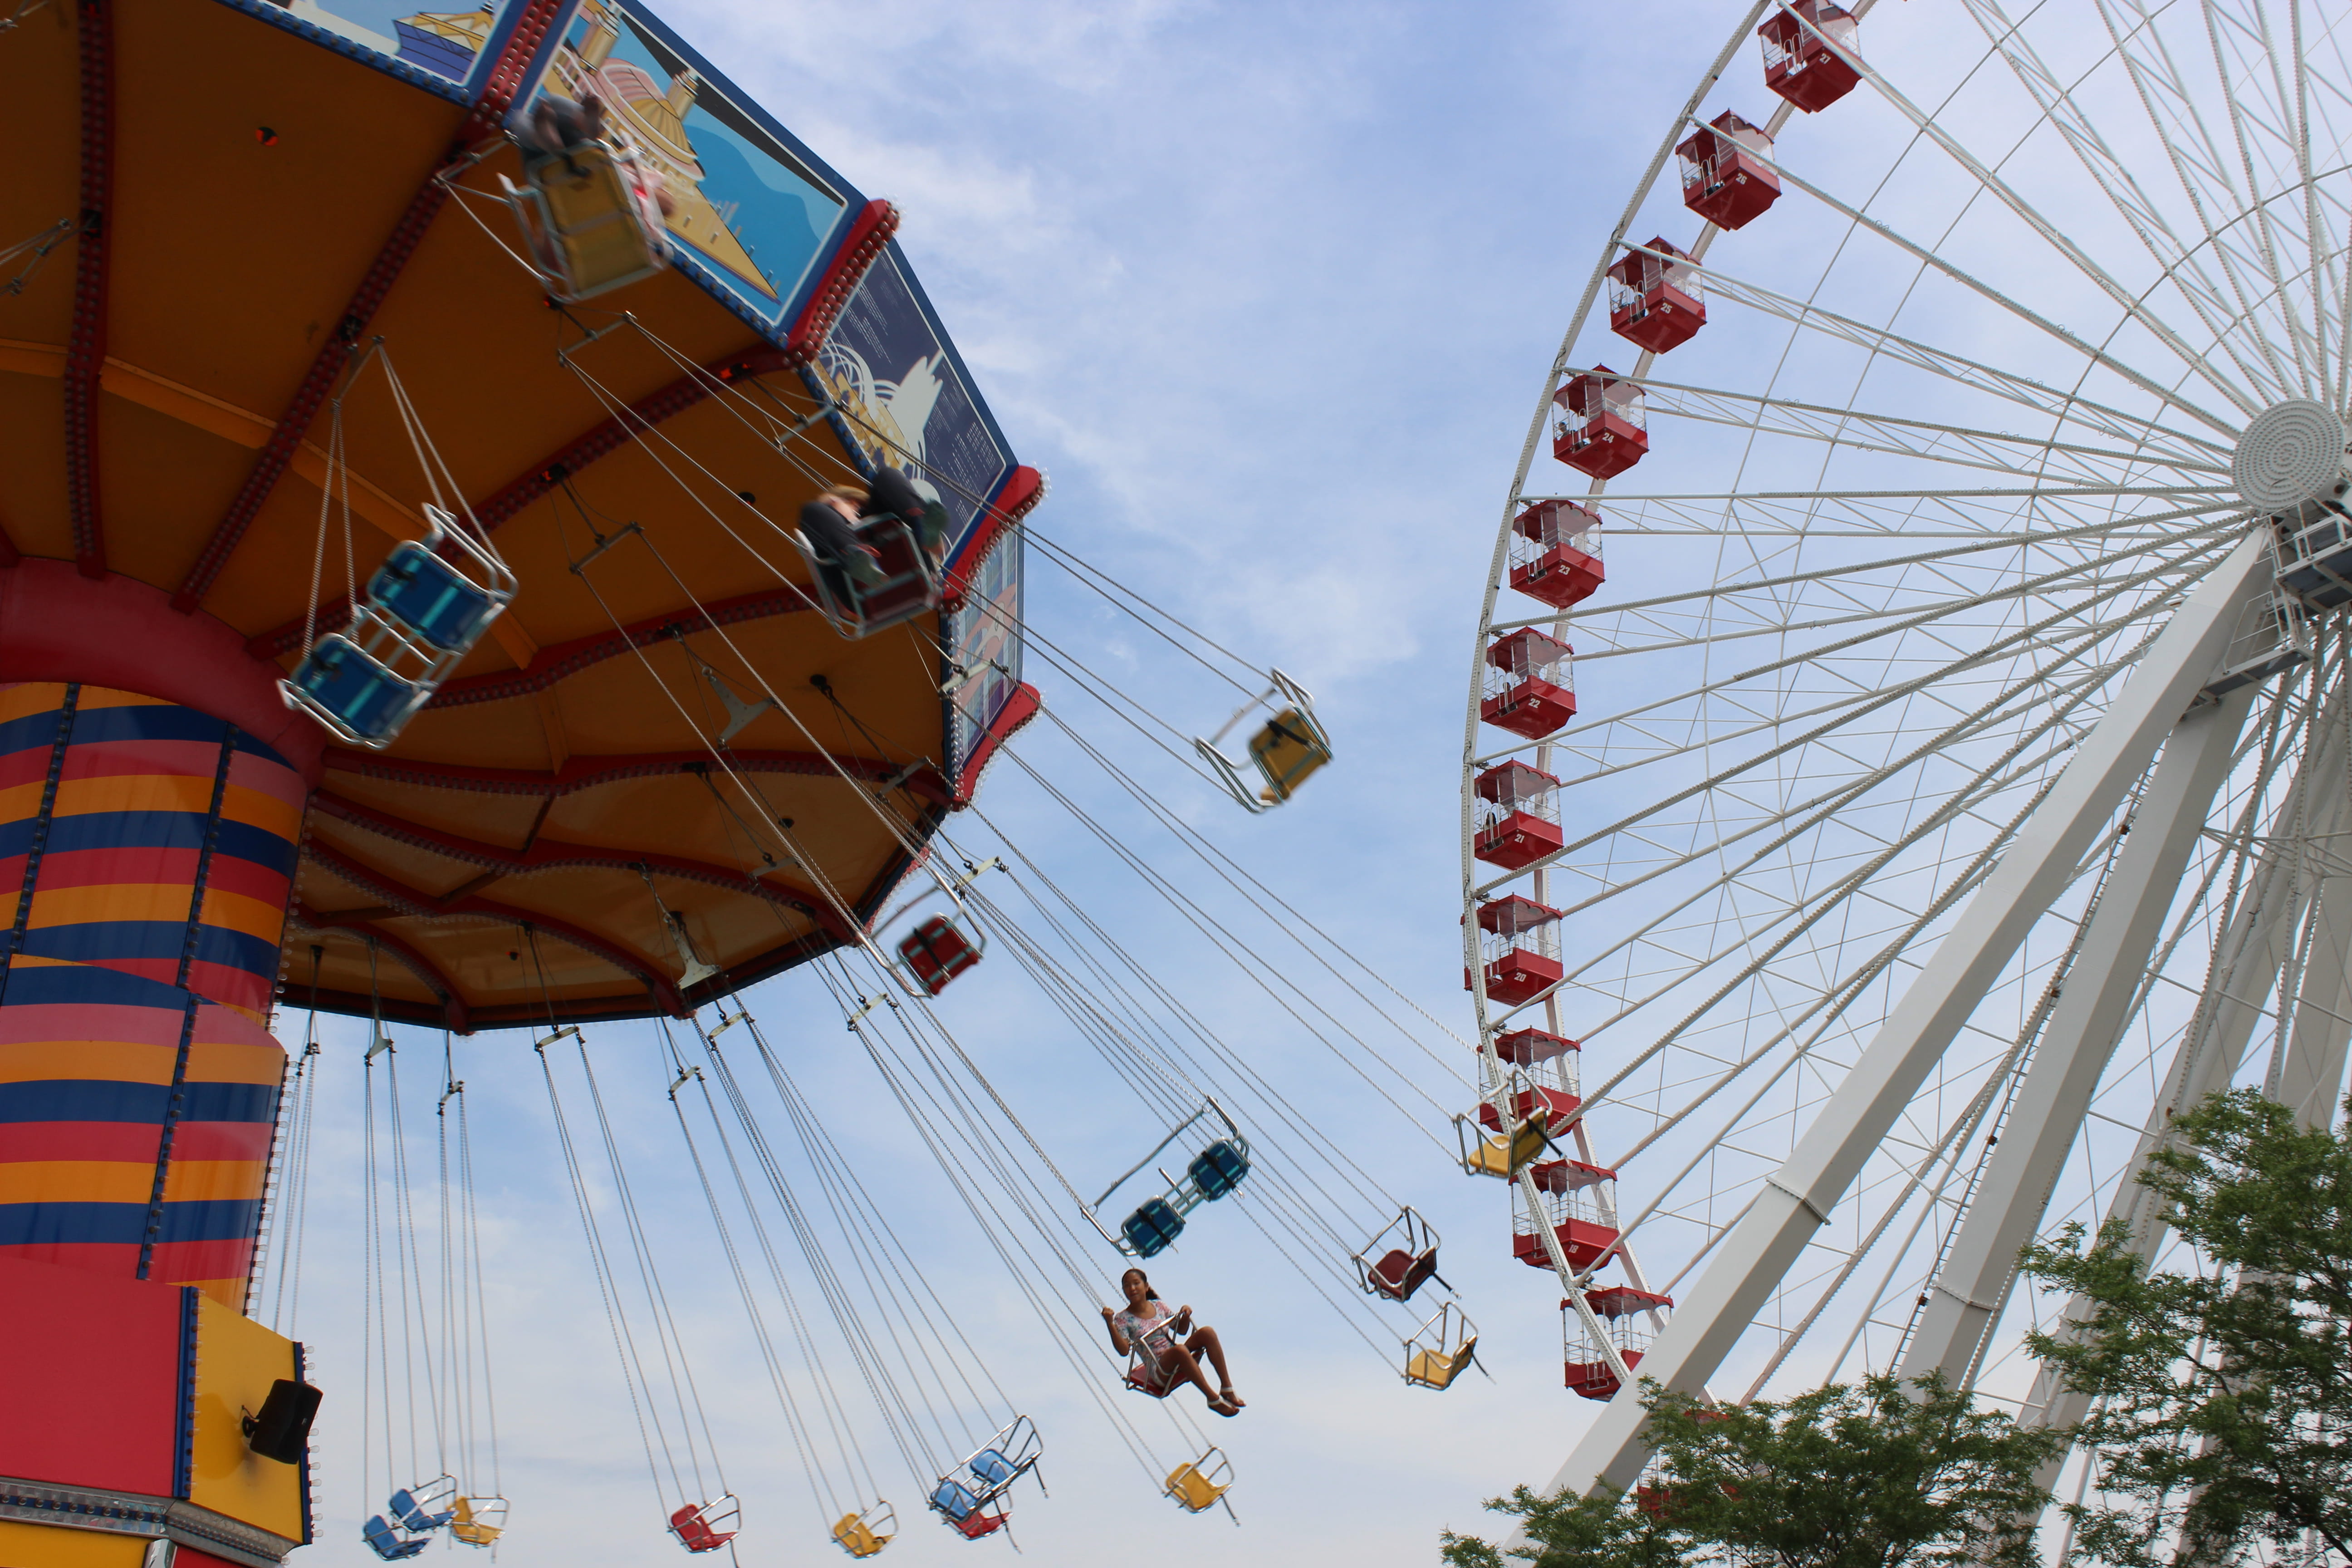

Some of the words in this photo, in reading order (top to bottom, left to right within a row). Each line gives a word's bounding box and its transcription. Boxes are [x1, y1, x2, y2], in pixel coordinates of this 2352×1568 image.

[1819, 53, 1831, 64] 27
[1735, 173, 1747, 185] 26
[1660, 302, 1672, 314] 25
[1602, 432, 1614, 443] 24
[1558, 564, 1570, 575] 23
[1528, 698, 1541, 708] 22
[1514, 833, 1525, 843] 21
[1514, 972, 1527, 982] 20
[1568, 1245, 1579, 1253] 18
